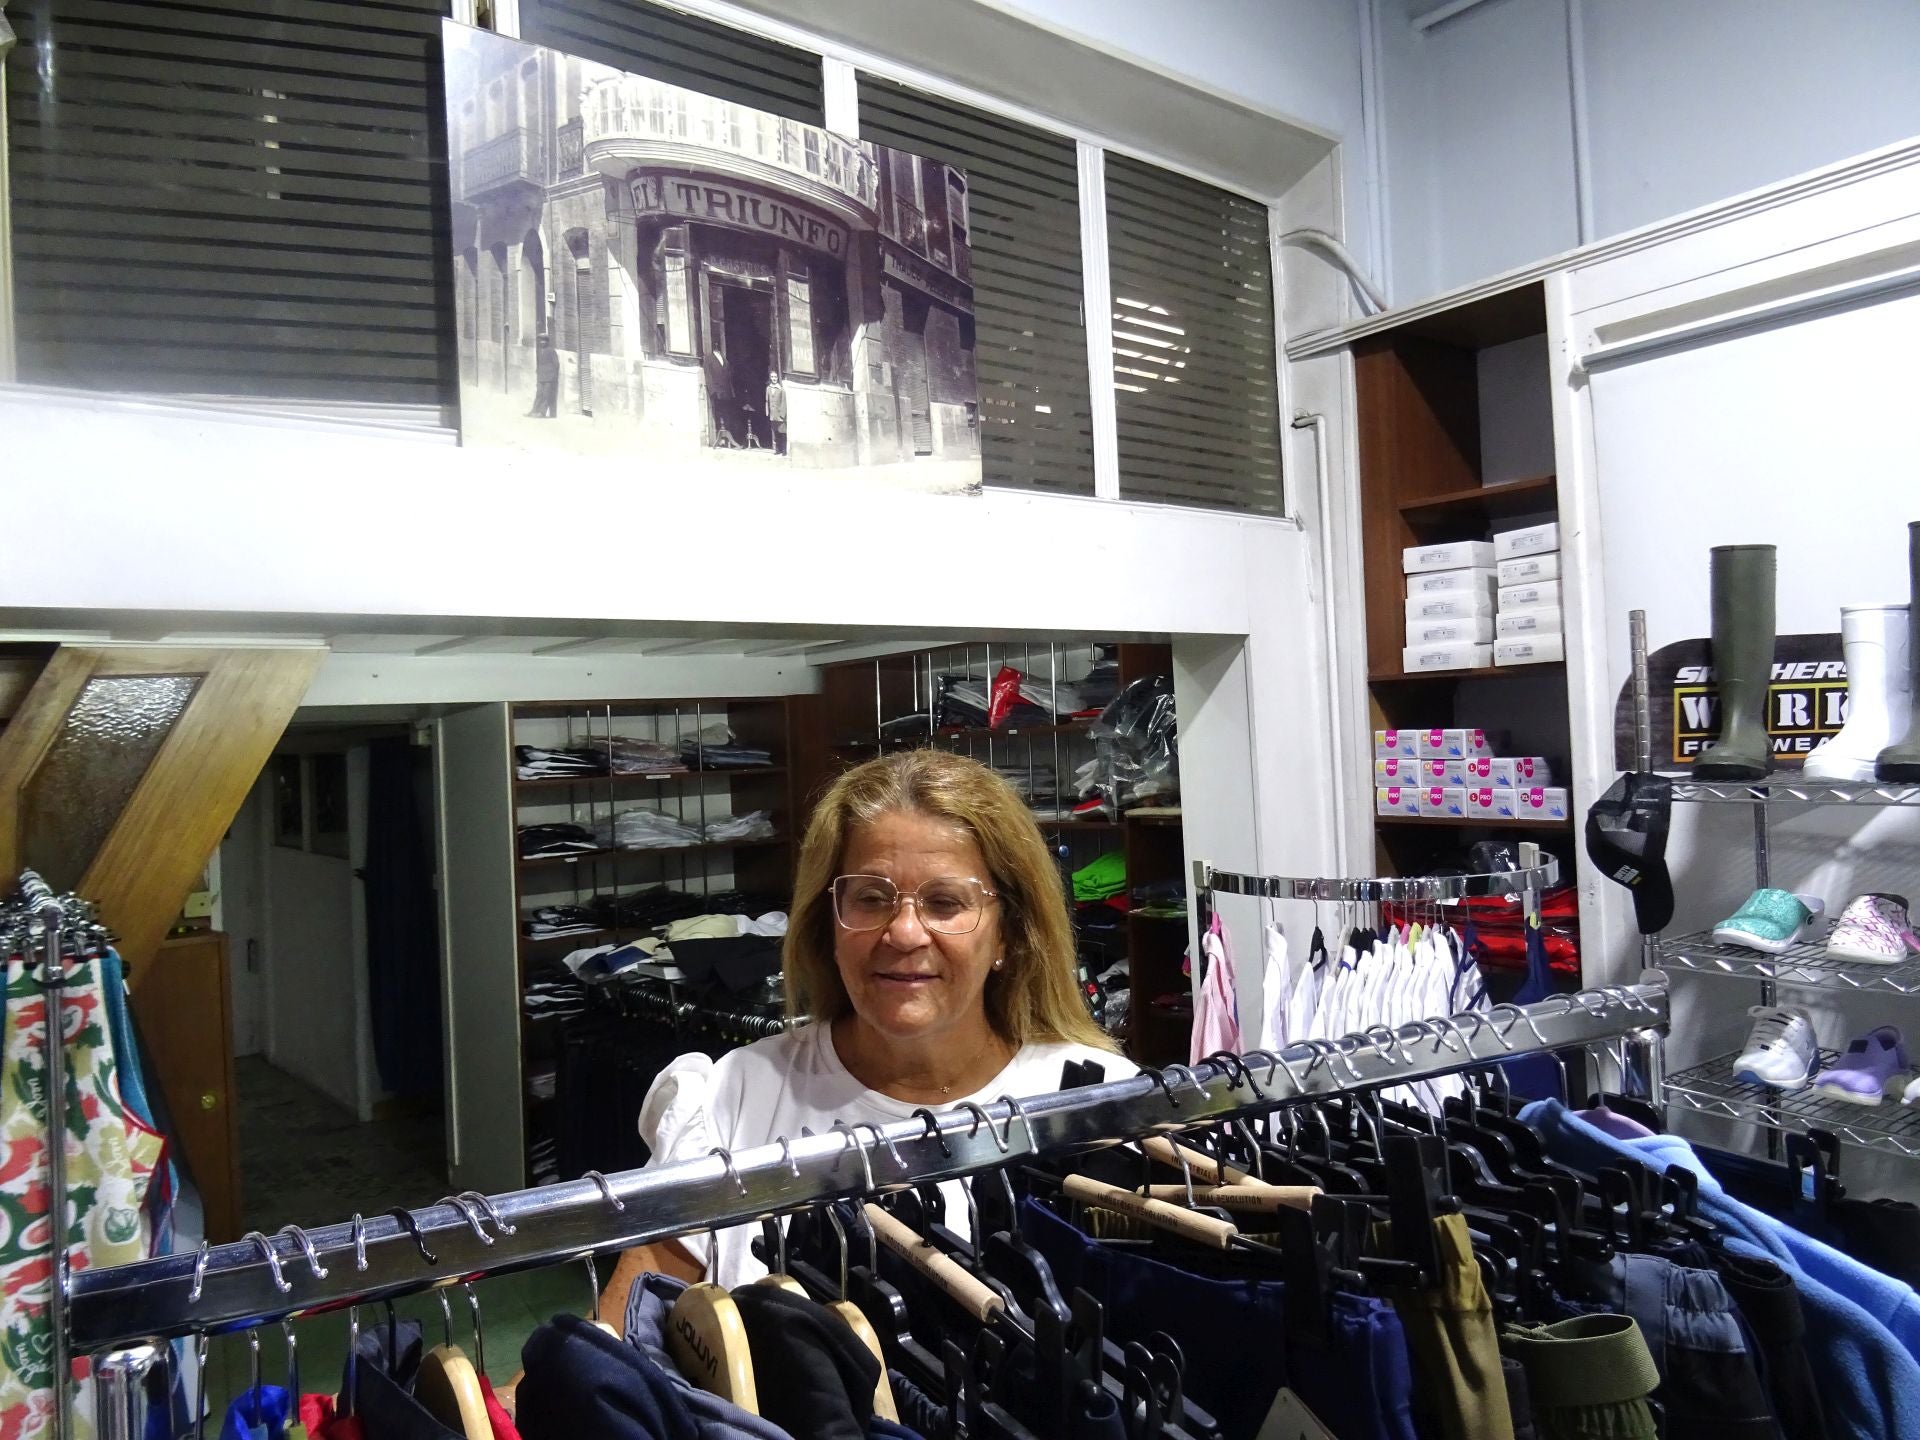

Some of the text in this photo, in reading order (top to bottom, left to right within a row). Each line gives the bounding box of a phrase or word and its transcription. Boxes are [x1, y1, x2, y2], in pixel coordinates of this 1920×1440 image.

[633, 183, 840, 253] EL TRIUNFO
[1681, 692, 1848, 729] WRK
[1171, 1155, 1213, 1180] INSTRIAL
[1216, 1194, 1263, 1204] REVOLUTION
[1136, 1205, 1178, 1227] REVOLUTION
